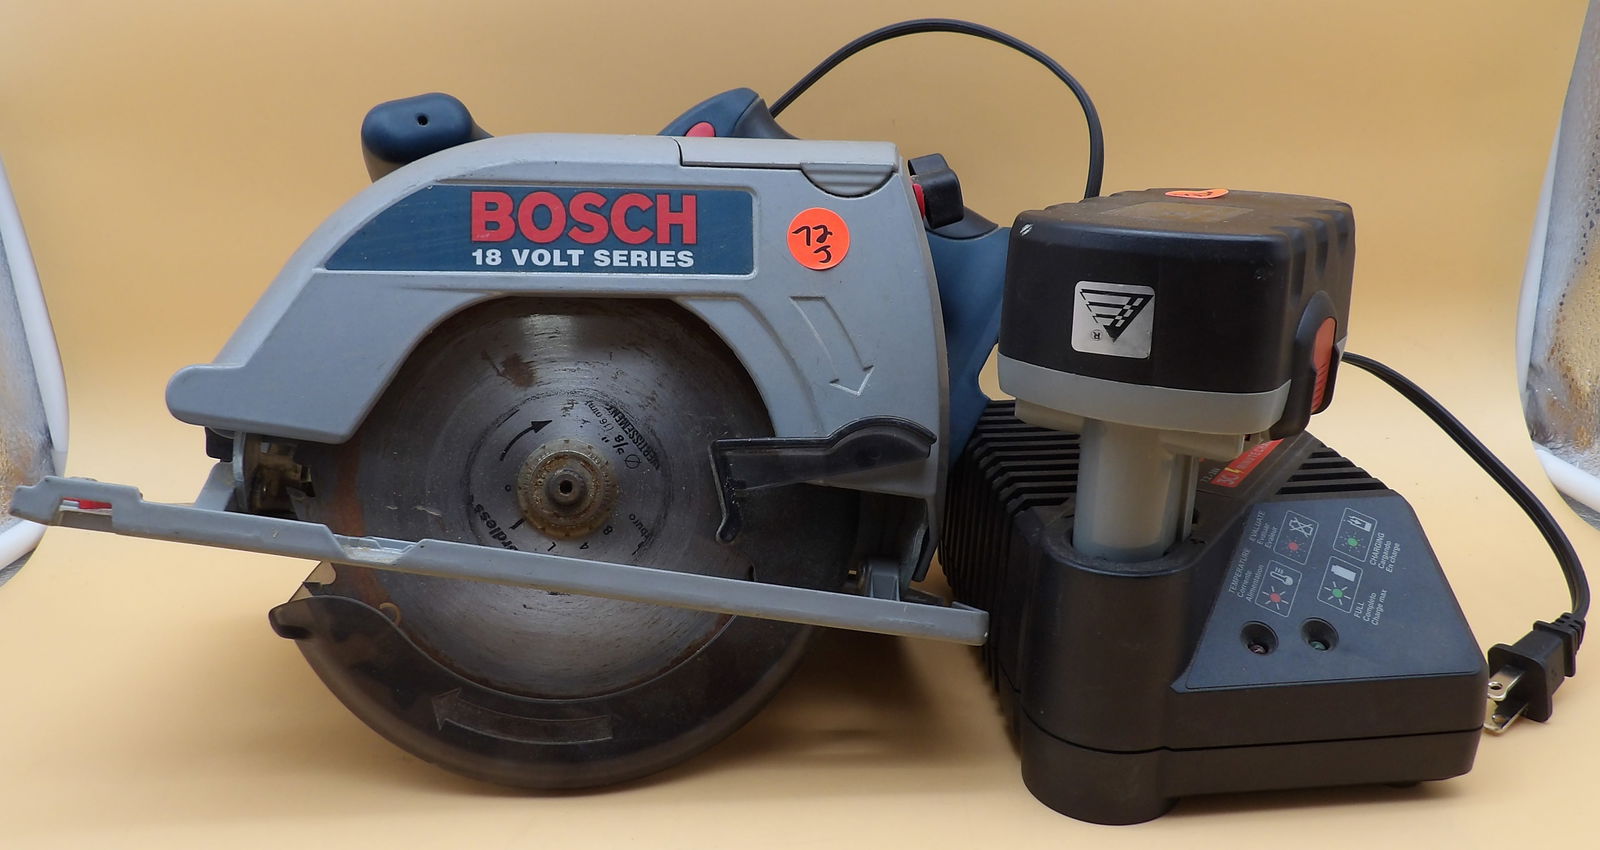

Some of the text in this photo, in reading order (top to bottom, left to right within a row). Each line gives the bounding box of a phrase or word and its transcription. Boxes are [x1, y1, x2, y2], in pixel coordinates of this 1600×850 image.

[470, 191, 698, 245] BOSCH
[471, 249, 695, 268] 18 VOLT SERIES
[1369, 532, 1385, 566] CHARGING
[1378, 540, 1392, 569] Cargando
[1385, 542, 1401, 573] En charge
[1228, 546, 1251, 594] TEMPERATUR
[1353, 601, 1365, 619] FULL
[1362, 592, 1377, 622] Completo
[1371, 603, 1385, 626] Charge
